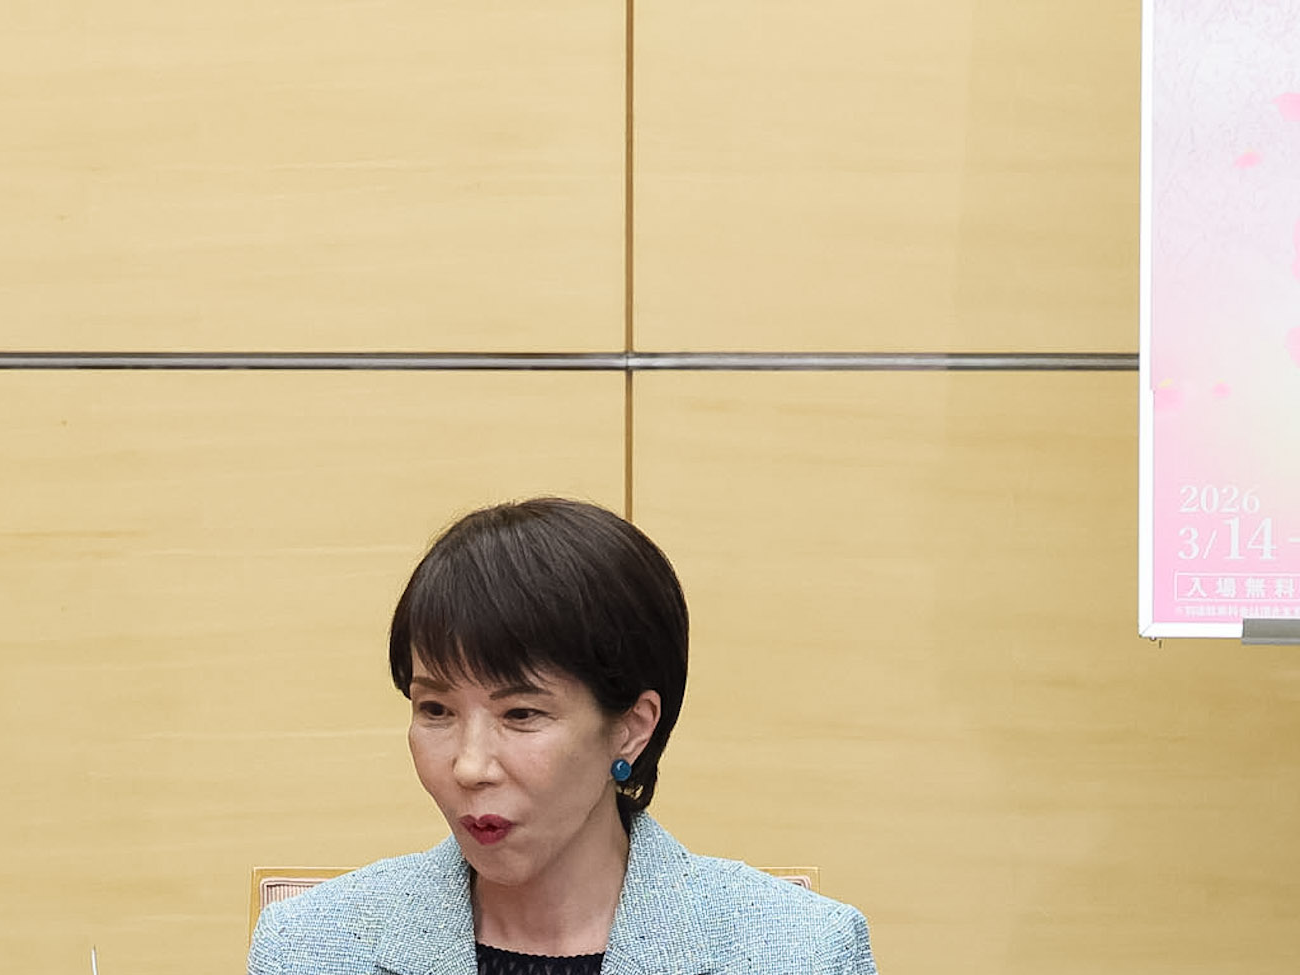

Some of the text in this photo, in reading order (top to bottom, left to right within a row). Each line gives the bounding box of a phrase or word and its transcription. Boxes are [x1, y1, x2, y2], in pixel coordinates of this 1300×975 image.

[1179, 485, 1261, 514] 2026
[1177, 516, 1277, 560] 3/14
[1187, 577, 1295, 598] 入場無料
